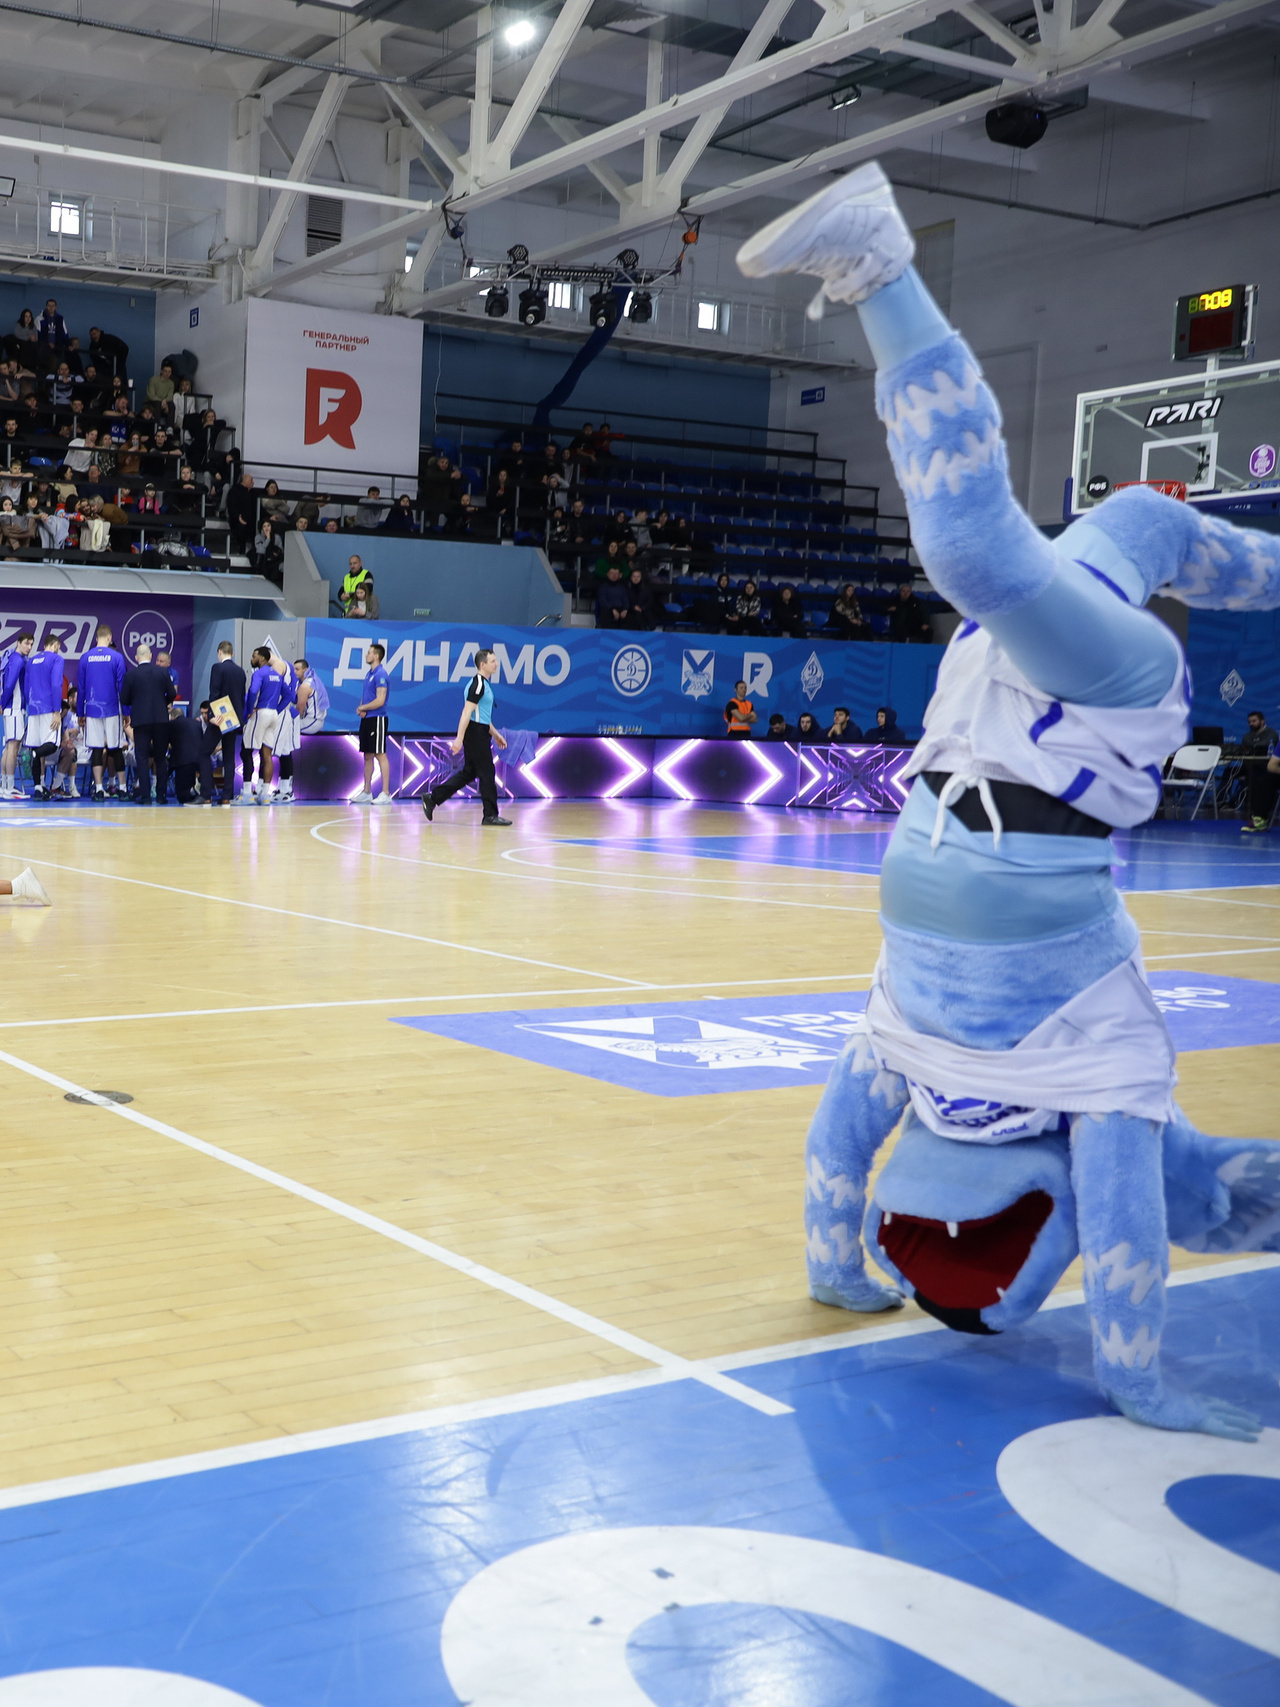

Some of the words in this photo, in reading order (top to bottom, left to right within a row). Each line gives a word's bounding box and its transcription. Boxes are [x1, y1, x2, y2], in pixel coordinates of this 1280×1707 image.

[1199, 289, 1232, 310] 7:08
[303, 330, 369, 345] ГЕНЕРАЛЬНЫЙ
[315, 341, 357, 352] ПАРТНЕР
[1146, 397, 1222, 427] PARI
[129, 632, 168, 649] РФБ
[333, 637, 571, 686] ДИНАМО
